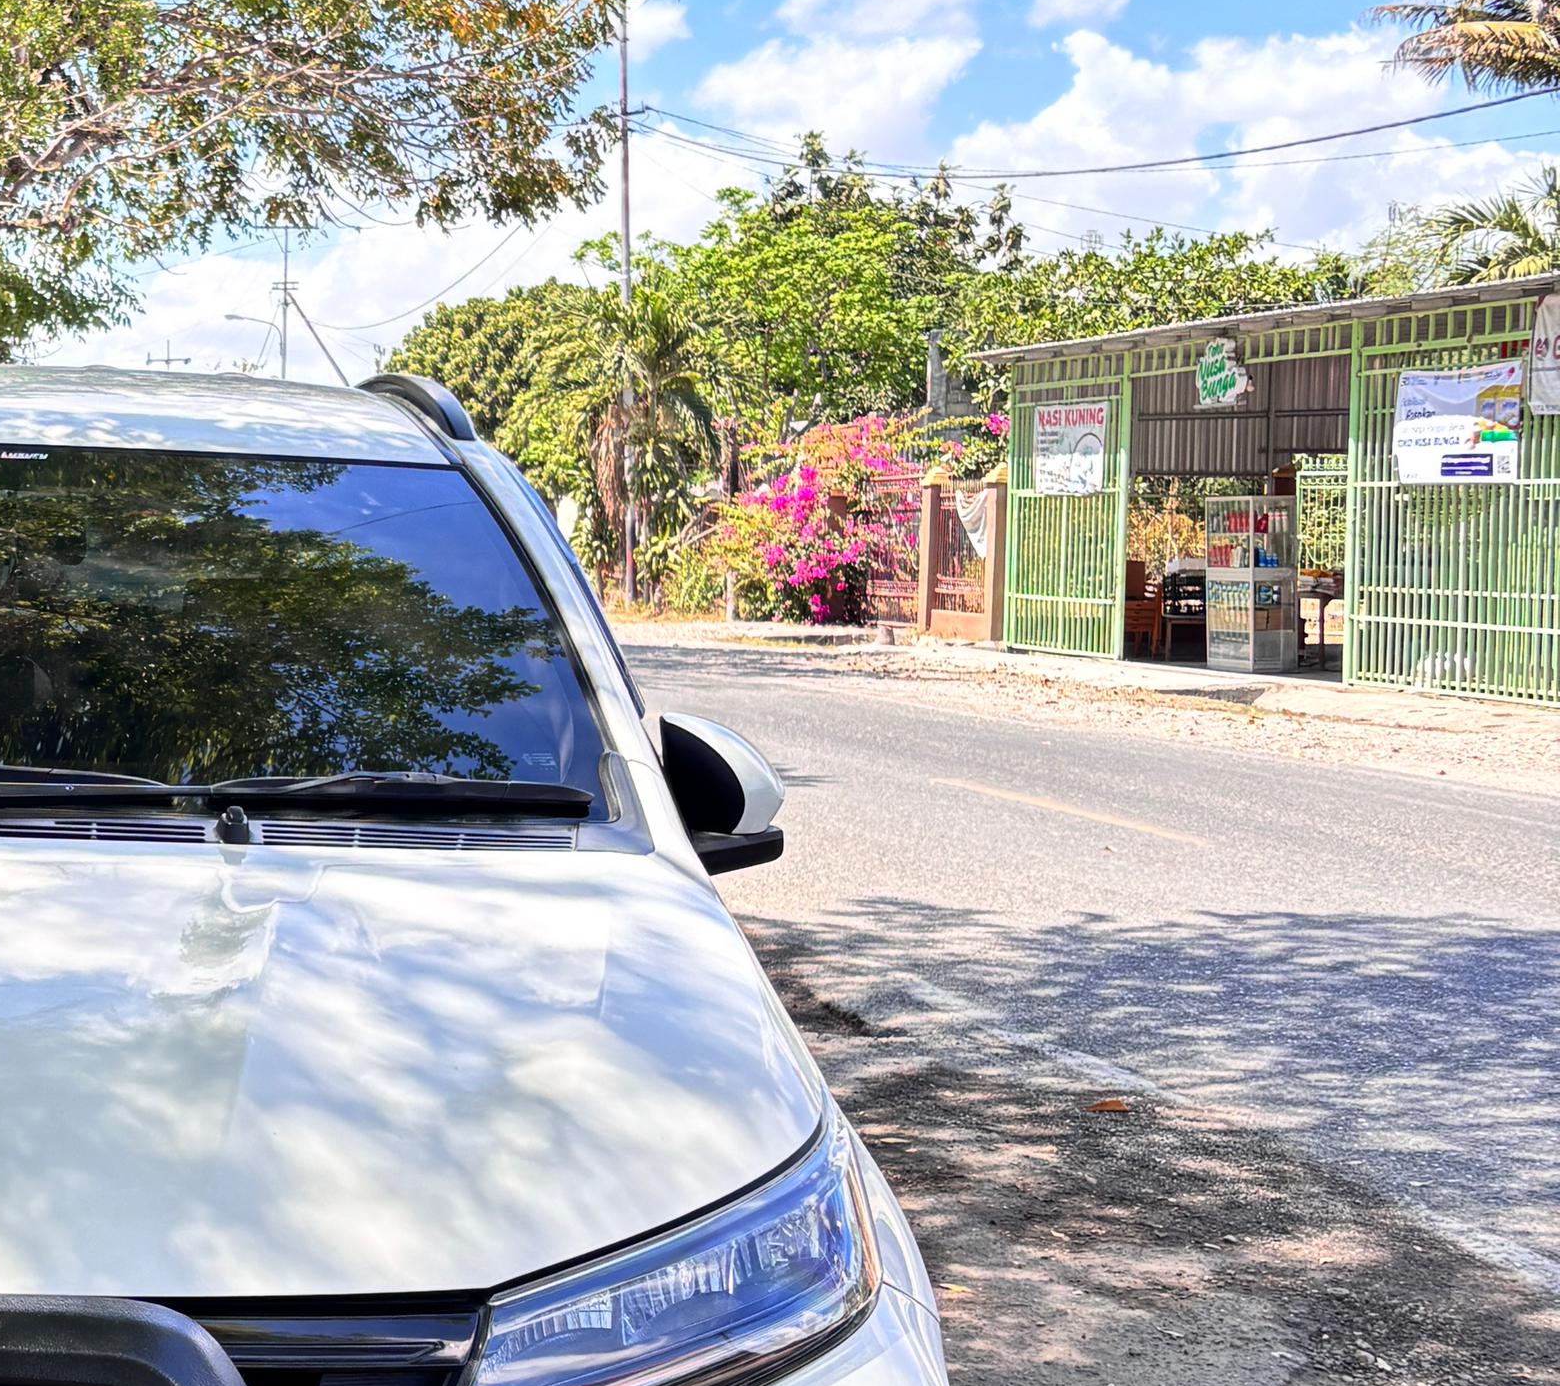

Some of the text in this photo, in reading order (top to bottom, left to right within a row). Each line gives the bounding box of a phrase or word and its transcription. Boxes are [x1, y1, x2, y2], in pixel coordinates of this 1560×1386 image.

[1198, 355, 1225, 381] Nusa
[1201, 371, 1236, 401] Bunga
[1038, 406, 1104, 429] NASI KUNING
